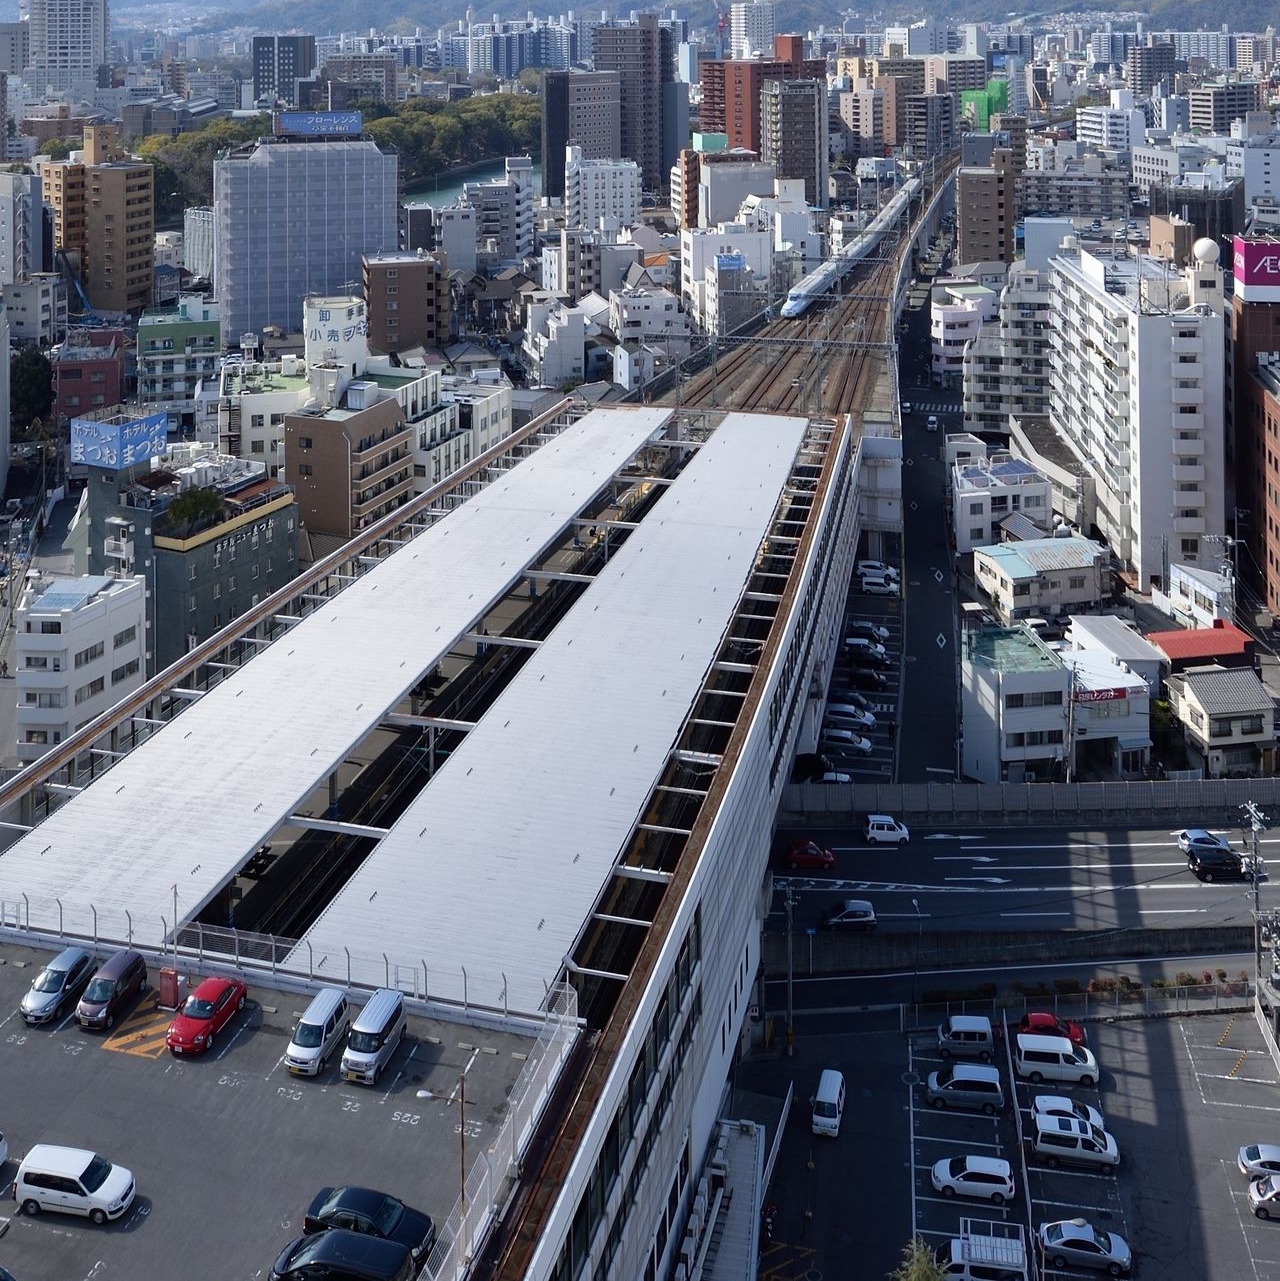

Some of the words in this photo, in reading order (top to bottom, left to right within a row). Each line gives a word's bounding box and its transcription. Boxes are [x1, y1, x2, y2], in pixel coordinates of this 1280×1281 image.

[307, 116, 358, 125] フローレンス
[309, 328, 340, 342] 小売
[73, 422, 99, 437] ホテル
[123, 422, 149, 438] ホテル
[74, 441, 118, 465] まつお
[123, 435, 166, 464] まつお
[391, 1111, 421, 1125] 225
